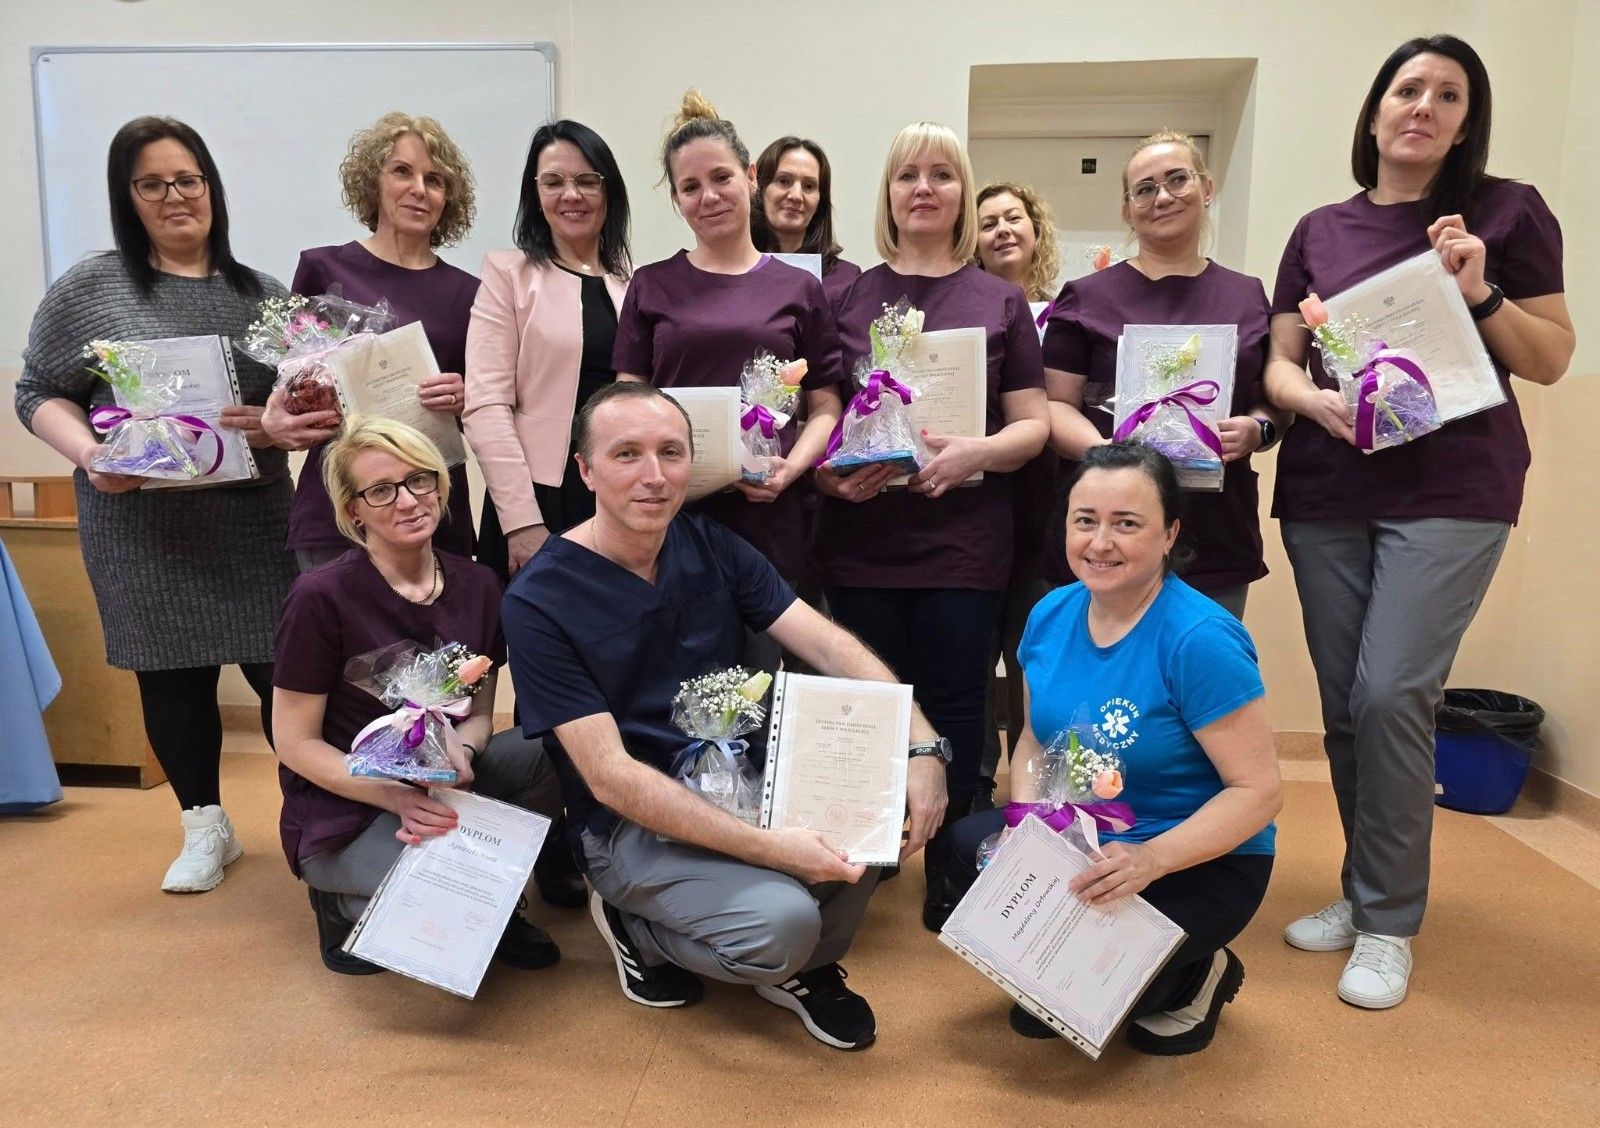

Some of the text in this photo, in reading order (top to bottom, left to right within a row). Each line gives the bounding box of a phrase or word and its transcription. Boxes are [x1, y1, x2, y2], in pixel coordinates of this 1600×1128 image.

[1100, 697, 1140, 719] OPIEKUN
[1092, 723, 1140, 750] MEDYCZNY
[459, 825, 502, 847] DYPLOM
[1001, 873, 1037, 919] DYPLOM
[1012, 908, 1038, 941] Magdaleny
